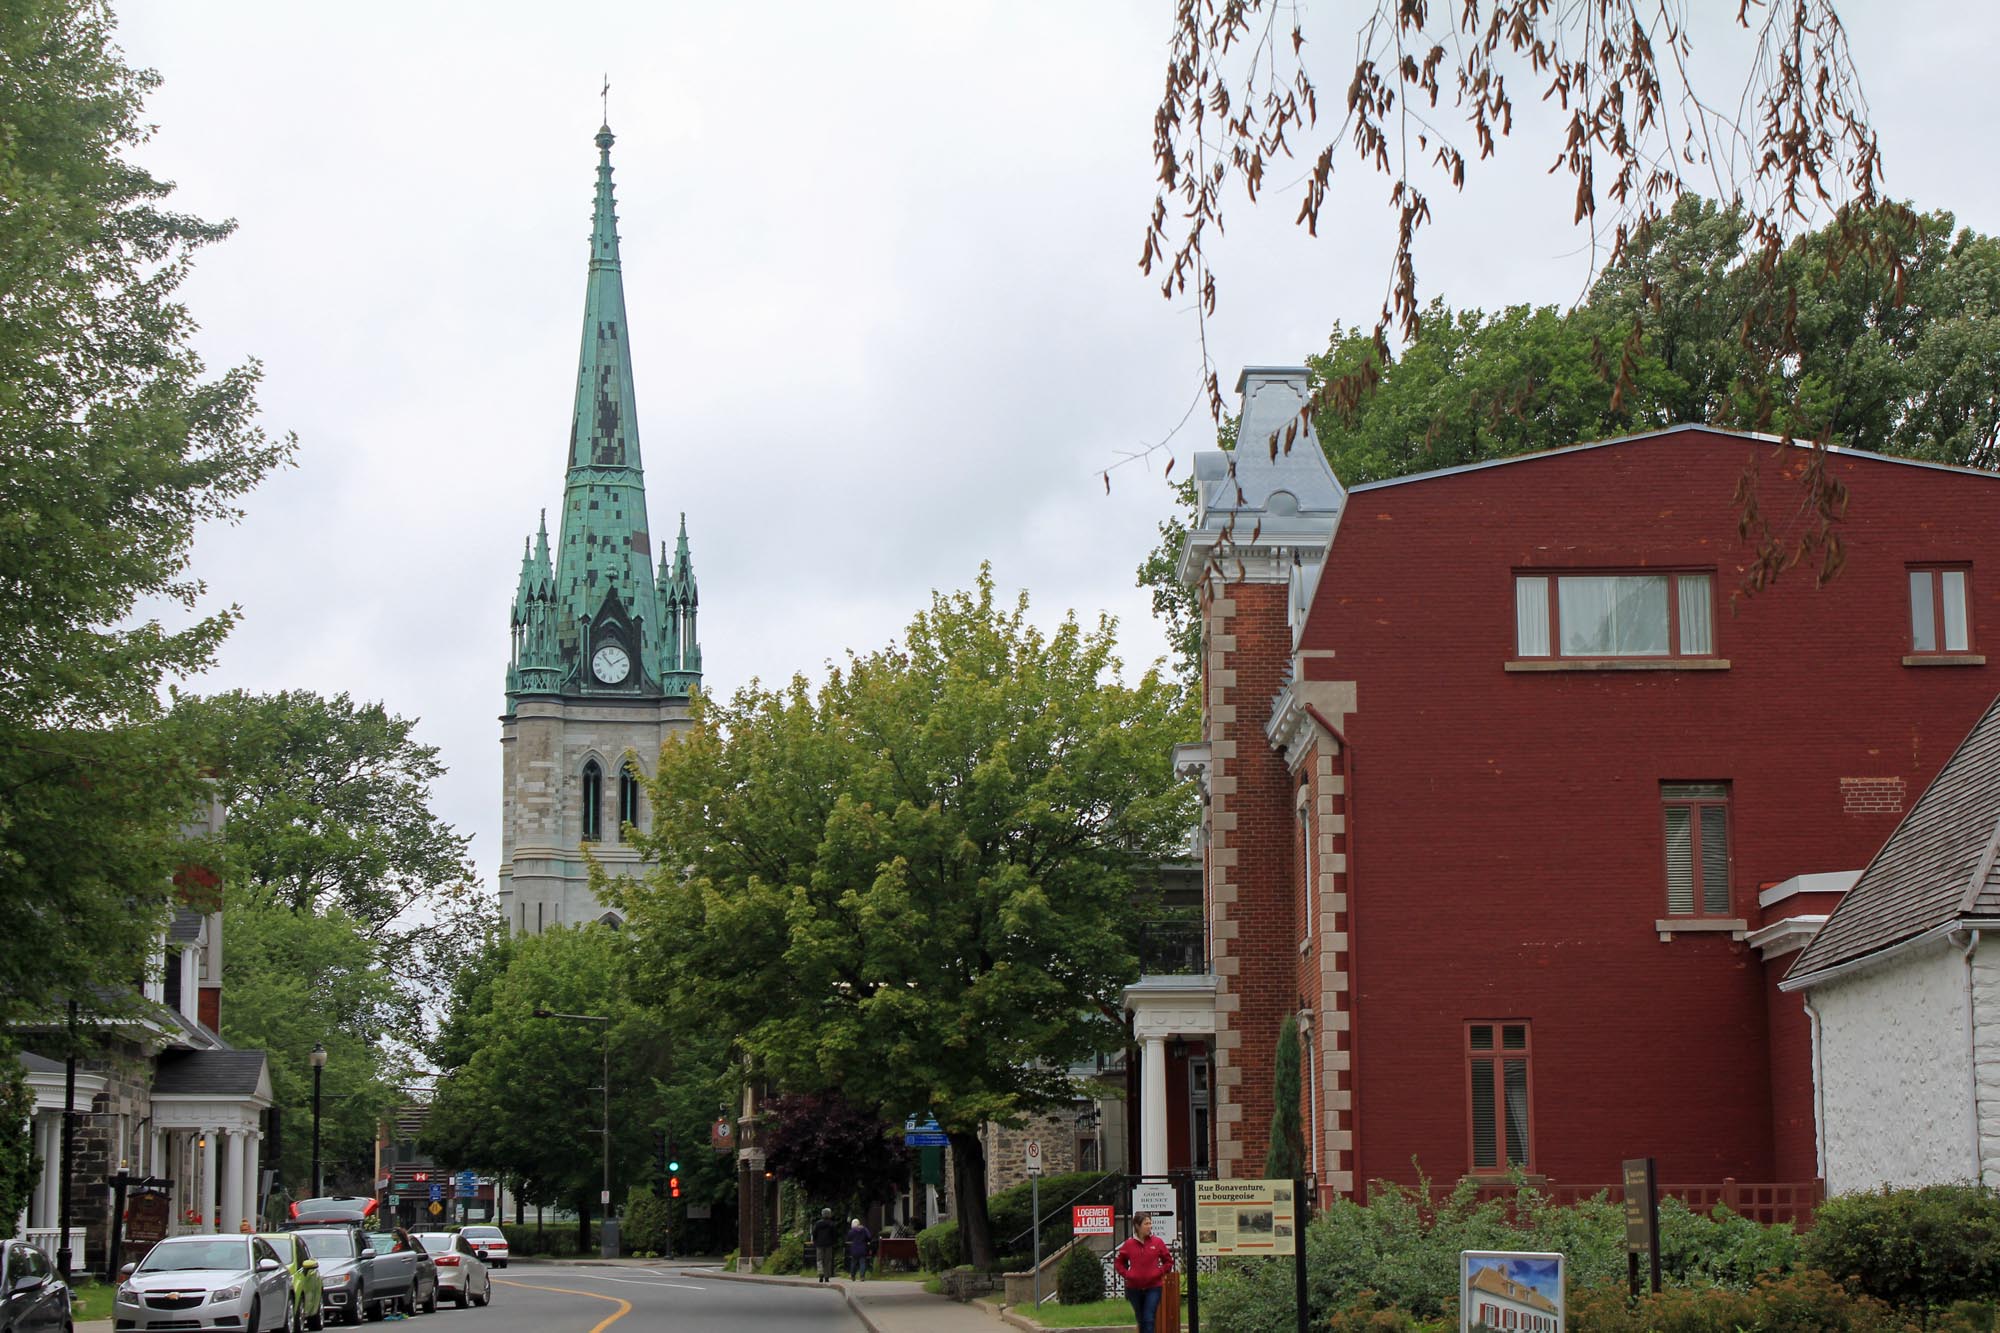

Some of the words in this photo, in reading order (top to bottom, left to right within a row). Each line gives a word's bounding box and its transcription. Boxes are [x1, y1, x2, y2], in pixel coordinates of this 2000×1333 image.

[1215, 1183, 1266, 1192] Bonaventure,
[1212, 1192, 1255, 1201] bourgeoise
[1077, 1208, 1109, 1216] LOGEMENT
[1082, 1217, 1110, 1227] LOUER
